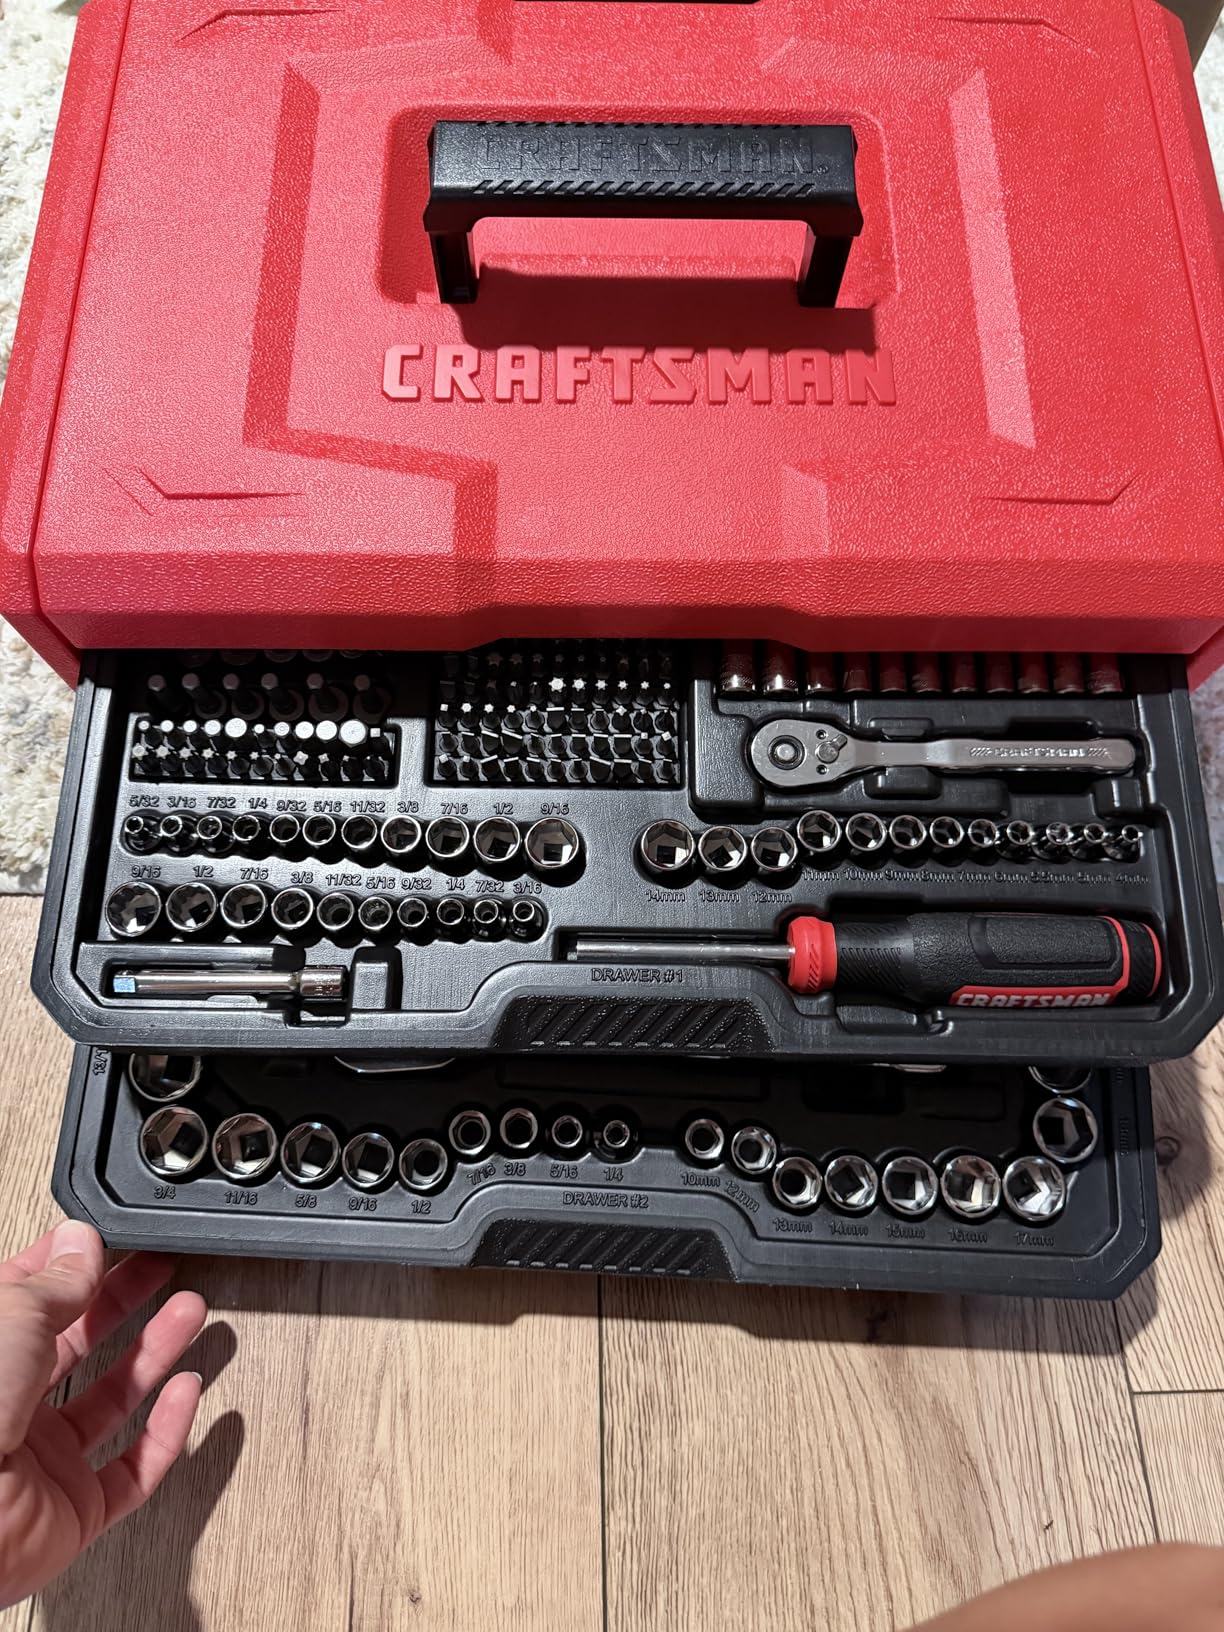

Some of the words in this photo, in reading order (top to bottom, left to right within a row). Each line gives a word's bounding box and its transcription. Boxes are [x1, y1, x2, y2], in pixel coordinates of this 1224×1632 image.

[479, 135, 815, 173] CRAFTSMAN
[381, 343, 897, 405] CRAFTSMAN
[128, 794, 160, 808] 5/32
[166, 796, 197, 809] 3/16
[207, 796, 236, 809] 7/32
[248, 797, 267, 810] 1/4
[276, 799, 307, 812] 9/32
[313, 800, 342, 813] 5/16
[350, 801, 385, 813] 11/32
[397, 801, 419, 813] 3/8
[441, 802, 468, 815] 7/16
[493, 802, 513, 815] 1/2
[541, 802, 569, 816] 9/16
[131, 865, 161, 878] 9/16
[193, 865, 214, 878] 1/2
[240, 867, 269, 880] 7/16
[291, 871, 314, 884] 3/8
[325, 873, 361, 887] 11/32
[366, 876, 395, 890] 5/16
[401, 877, 432, 890] 9/32
[446, 878, 465, 890] 1/4
[475, 879, 504, 893] 7/32
[513, 881, 542, 894] 3/16
[645, 889, 685, 903] 14mm
[700, 890, 740, 903] 13mm
[752, 891, 792, 904] 12mm
[591, 968, 661, 983] DRAWER
[664, 969, 684, 983] #1
[956, 993, 1110, 1008] CRAFTSMAN
[503, 1162, 526, 1176] 3/8
[550, 1165, 578, 1179] 5/16
[603, 1167, 623, 1181] 1/4
[153, 1185, 177, 1199] 3/4
[224, 1190, 258, 1205] 11/16
[295, 1194, 317, 1208] 5/8
[348, 1196, 378, 1211] 9/16
[411, 1200, 431, 1214] 1/2
[563, 1191, 628, 1207] DRAWER
[630, 1194, 649, 1208] #2
[681, 1172, 720, 1187] 10mm
[725, 1180, 760, 1213] 12mm
